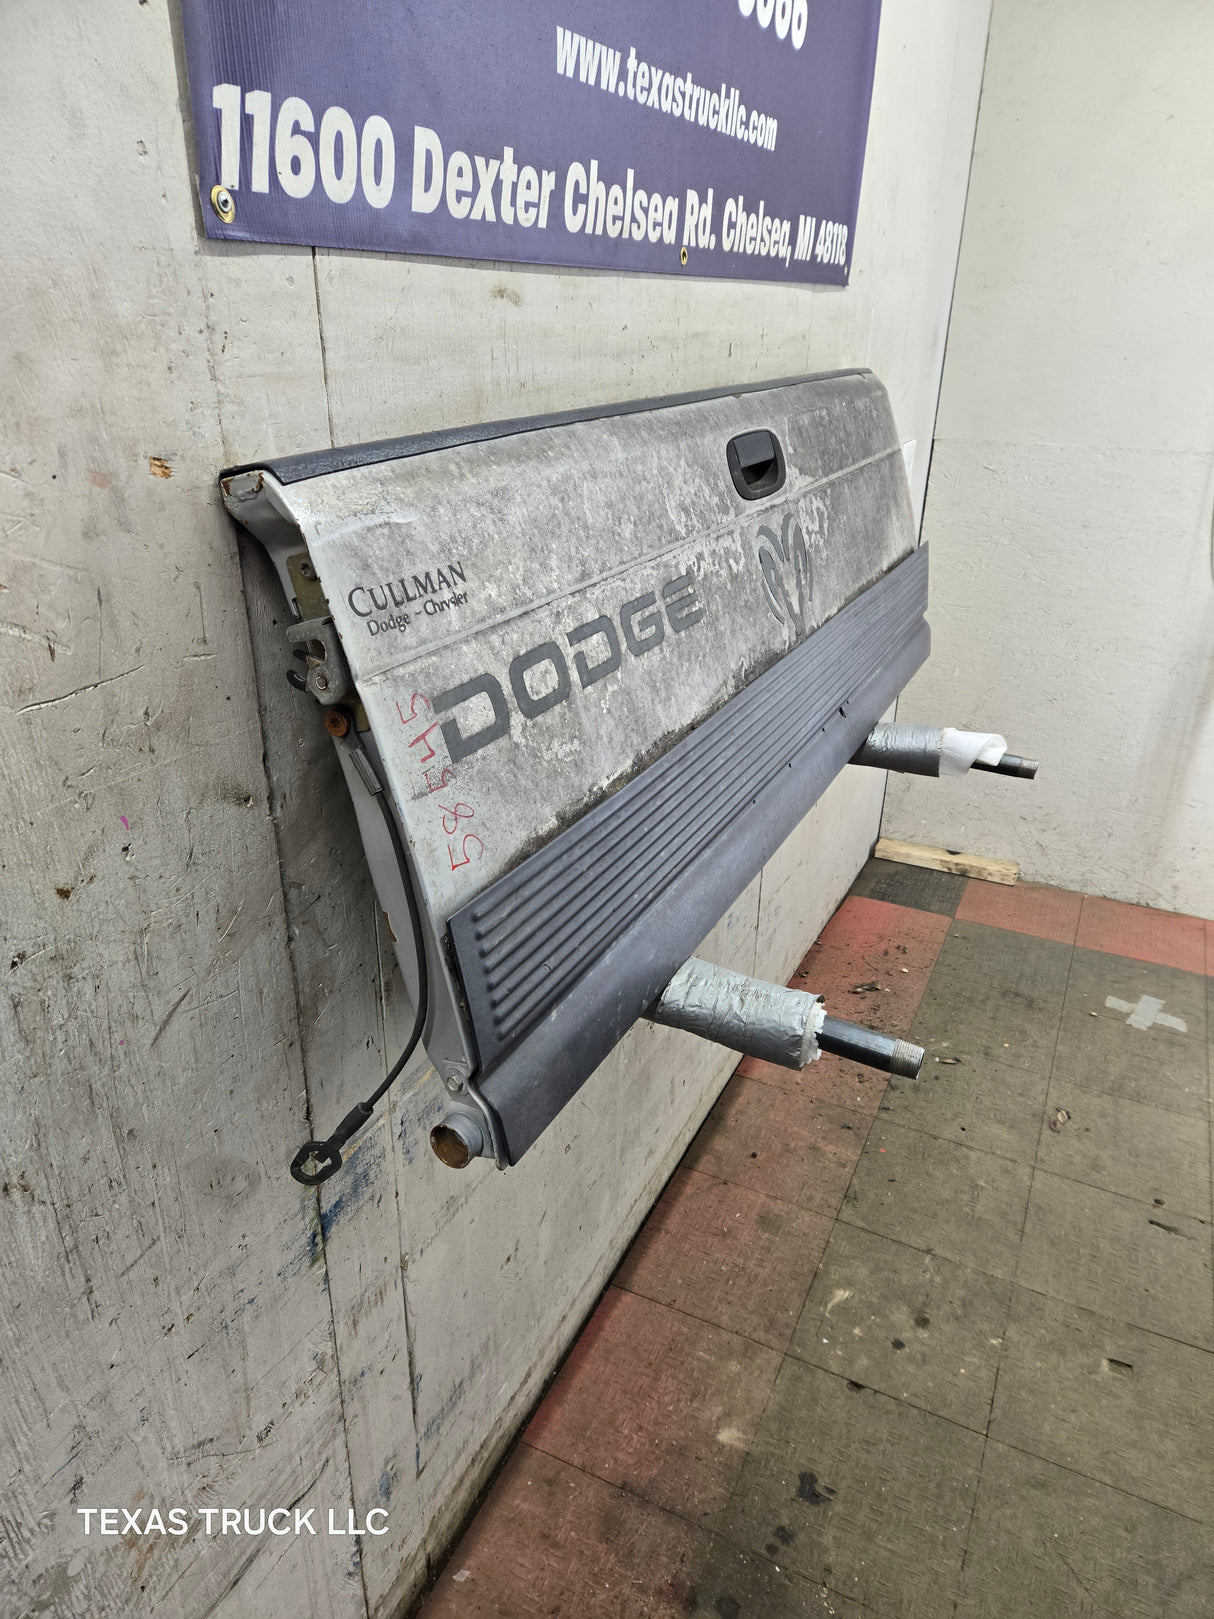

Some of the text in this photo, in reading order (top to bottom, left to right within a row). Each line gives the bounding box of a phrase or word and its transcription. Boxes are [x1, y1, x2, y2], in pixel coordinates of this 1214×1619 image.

[556, 25, 778, 152] www.texastruckllc.com
[212, 83, 849, 268] 11600 Dexter Chelsea Rd. Chelsea, MI 48118
[347, 561, 467, 617] CULLMAN
[366, 613, 411, 637] Dodge
[433, 574, 705, 764] DODGE
